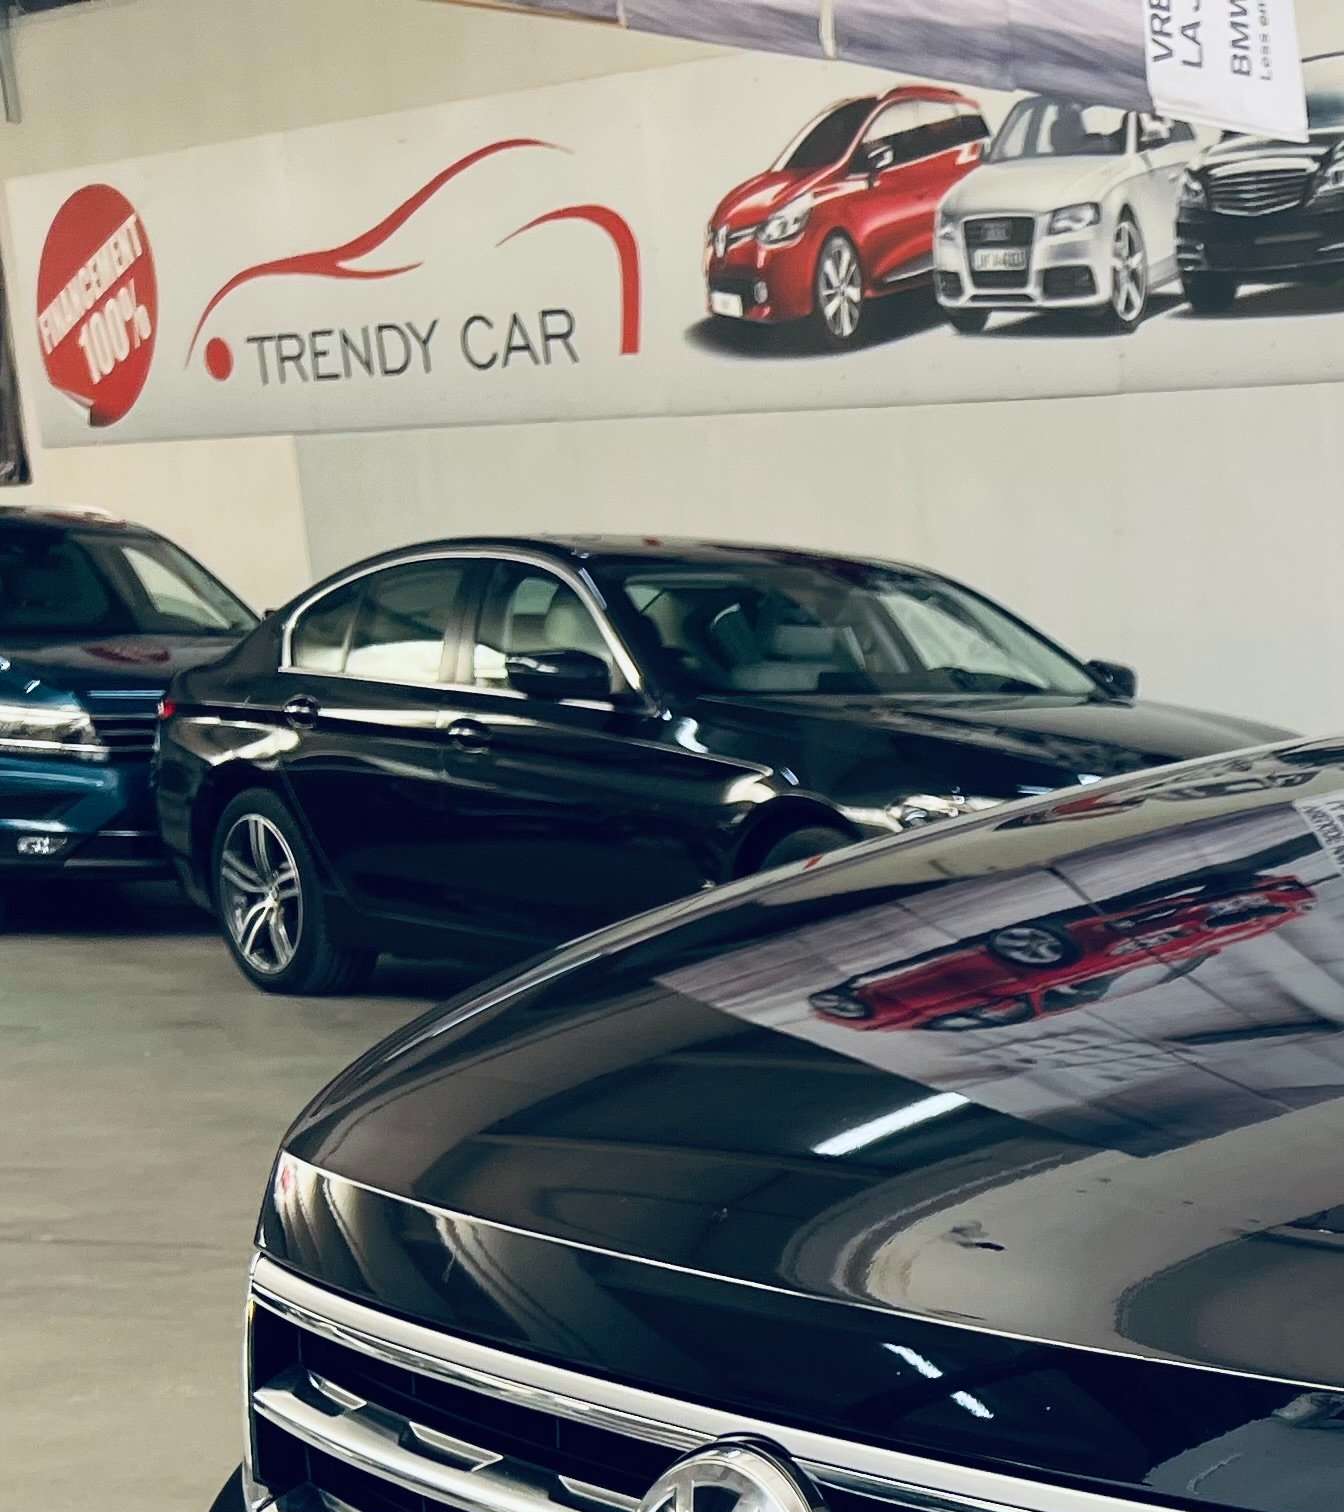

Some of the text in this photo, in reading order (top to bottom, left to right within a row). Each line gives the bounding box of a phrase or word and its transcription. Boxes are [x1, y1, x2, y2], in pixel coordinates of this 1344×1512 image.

[39, 213, 143, 354] FINANCEMENT
[79, 278, 153, 384] 100%
[246, 307, 581, 386] TRENDY CAR
